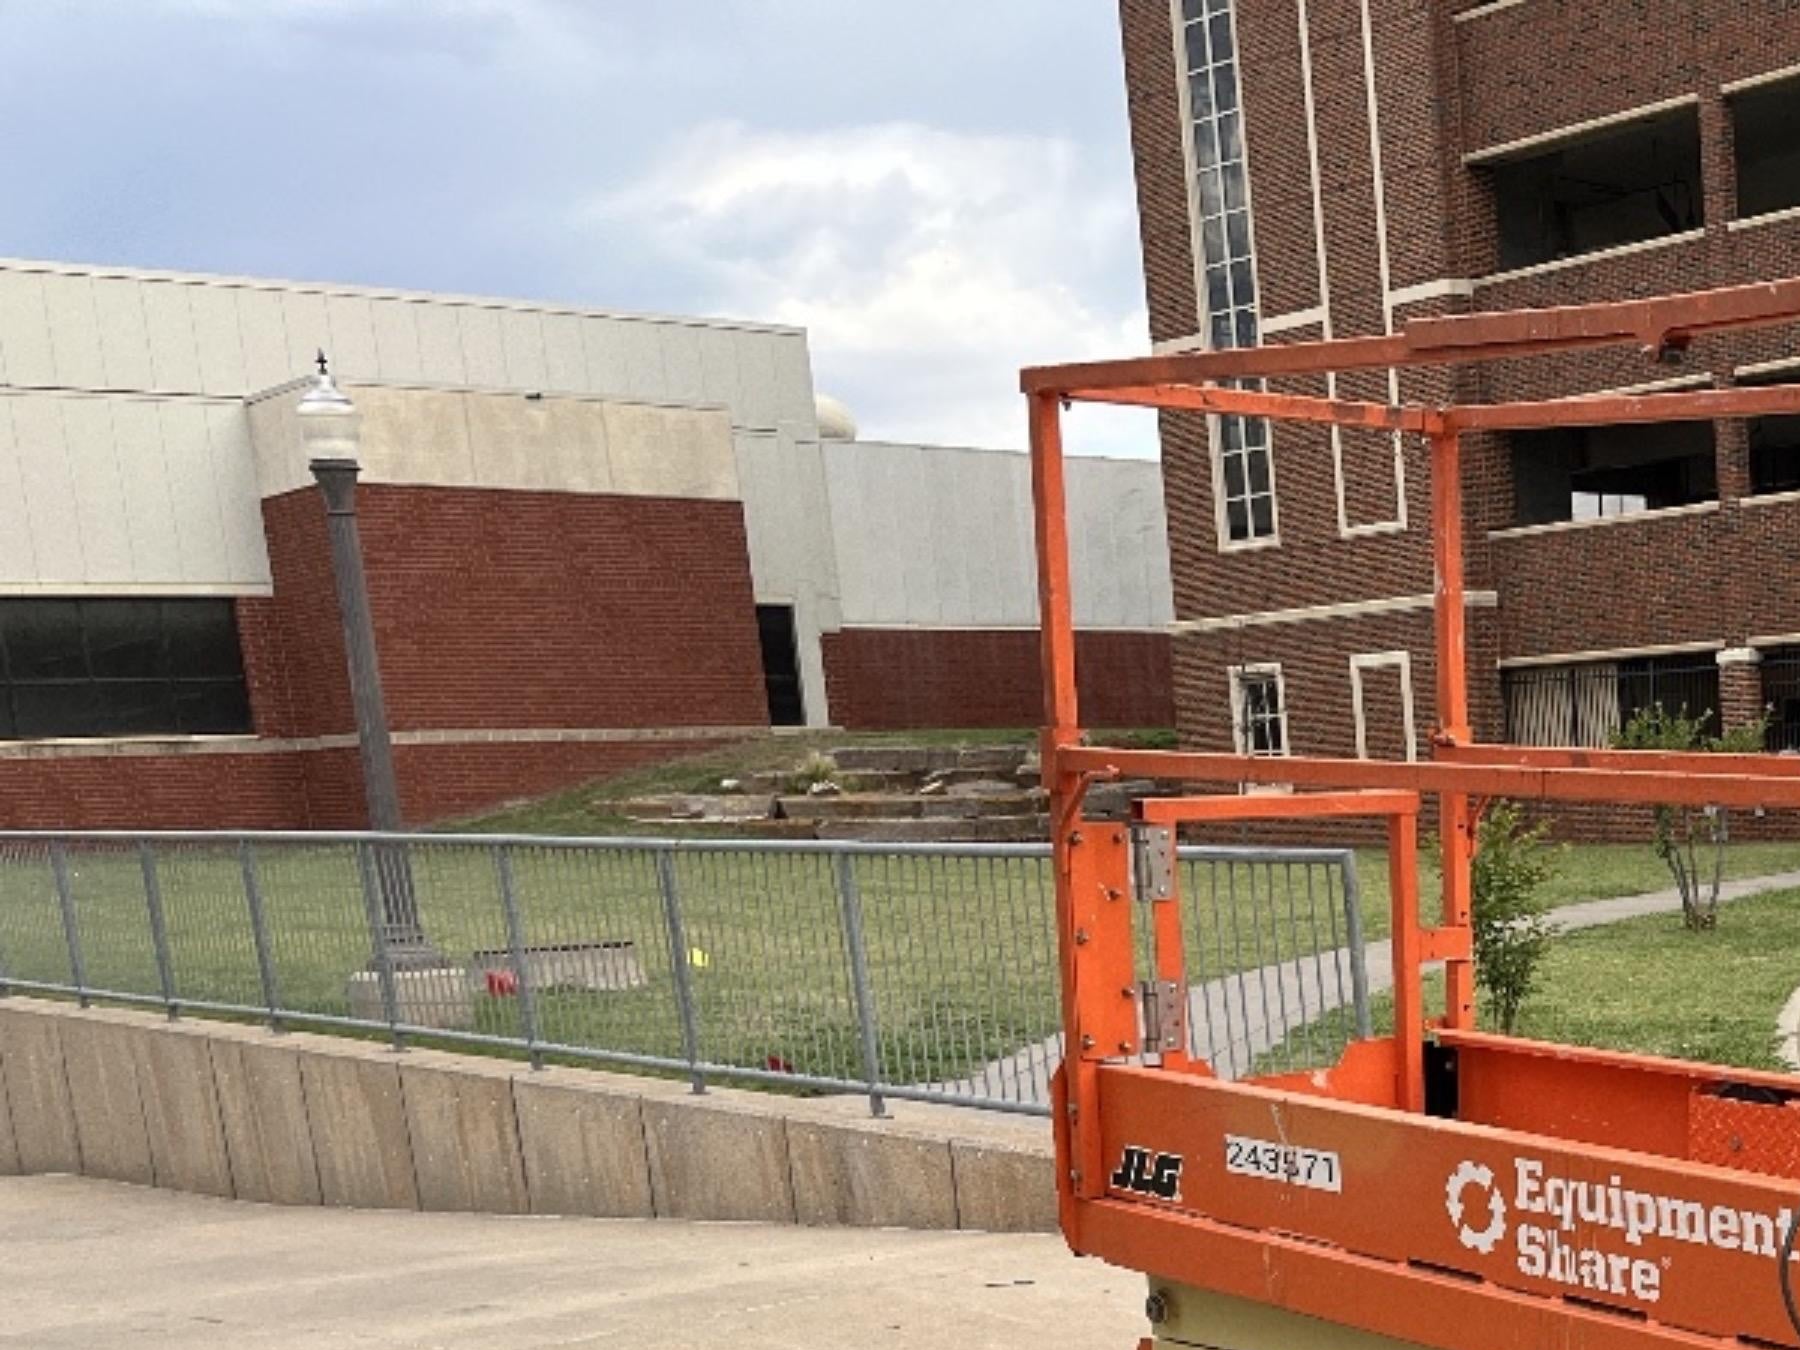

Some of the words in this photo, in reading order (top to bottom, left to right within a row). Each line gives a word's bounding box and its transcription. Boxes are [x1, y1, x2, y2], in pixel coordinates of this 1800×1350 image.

[1112, 1145, 1183, 1200] JLG
[1227, 1142, 1334, 1183] 243571
[1514, 1157, 1800, 1262] Equipment
[1517, 1225, 1661, 1301] Share
